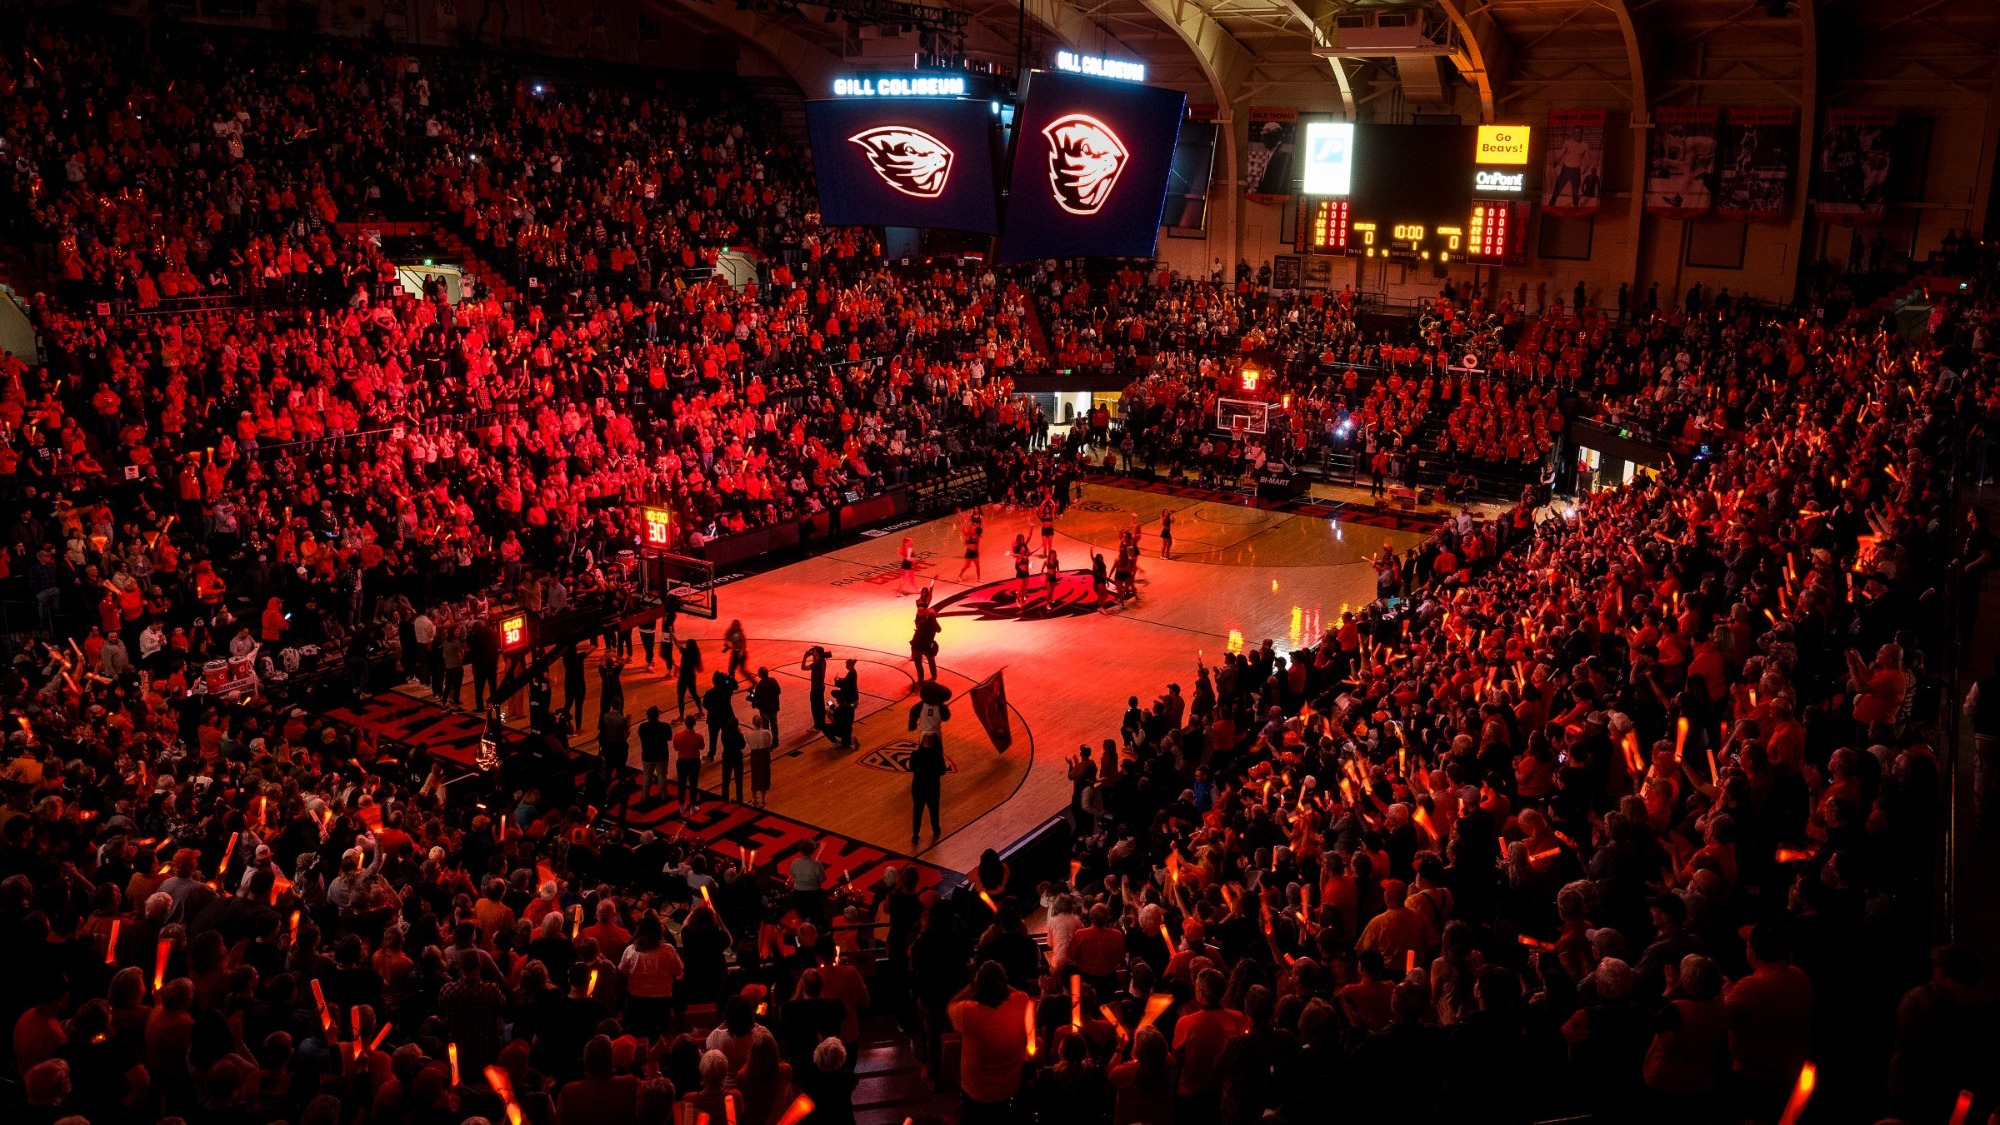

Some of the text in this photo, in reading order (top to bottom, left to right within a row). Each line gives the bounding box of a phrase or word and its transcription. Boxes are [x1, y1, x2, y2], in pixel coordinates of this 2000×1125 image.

[834, 78, 963, 95] GILL COLISEUM
[1496, 133, 1511, 141] Go
[1482, 143, 1523, 153] Beavs!
[1476, 172, 1522, 186] OnPoint
[1365, 231, 1374, 244] 0
[1394, 225, 1424, 240] 10:00
[1449, 235, 1459, 249] 0
[1367, 248, 1374, 257] 0
[1381, 249, 1389, 258] 4
[1421, 251, 1429, 260] 4
[1440, 251, 1448, 262] 0
[1242, 377, 1256, 390] 30
[1259, 476, 1290, 486] BI-MART
[648, 521, 667, 543] 30
[505, 629, 520, 644] 30
[927, 708, 934, 717] 0
[410, 773, 421, 783] 15
